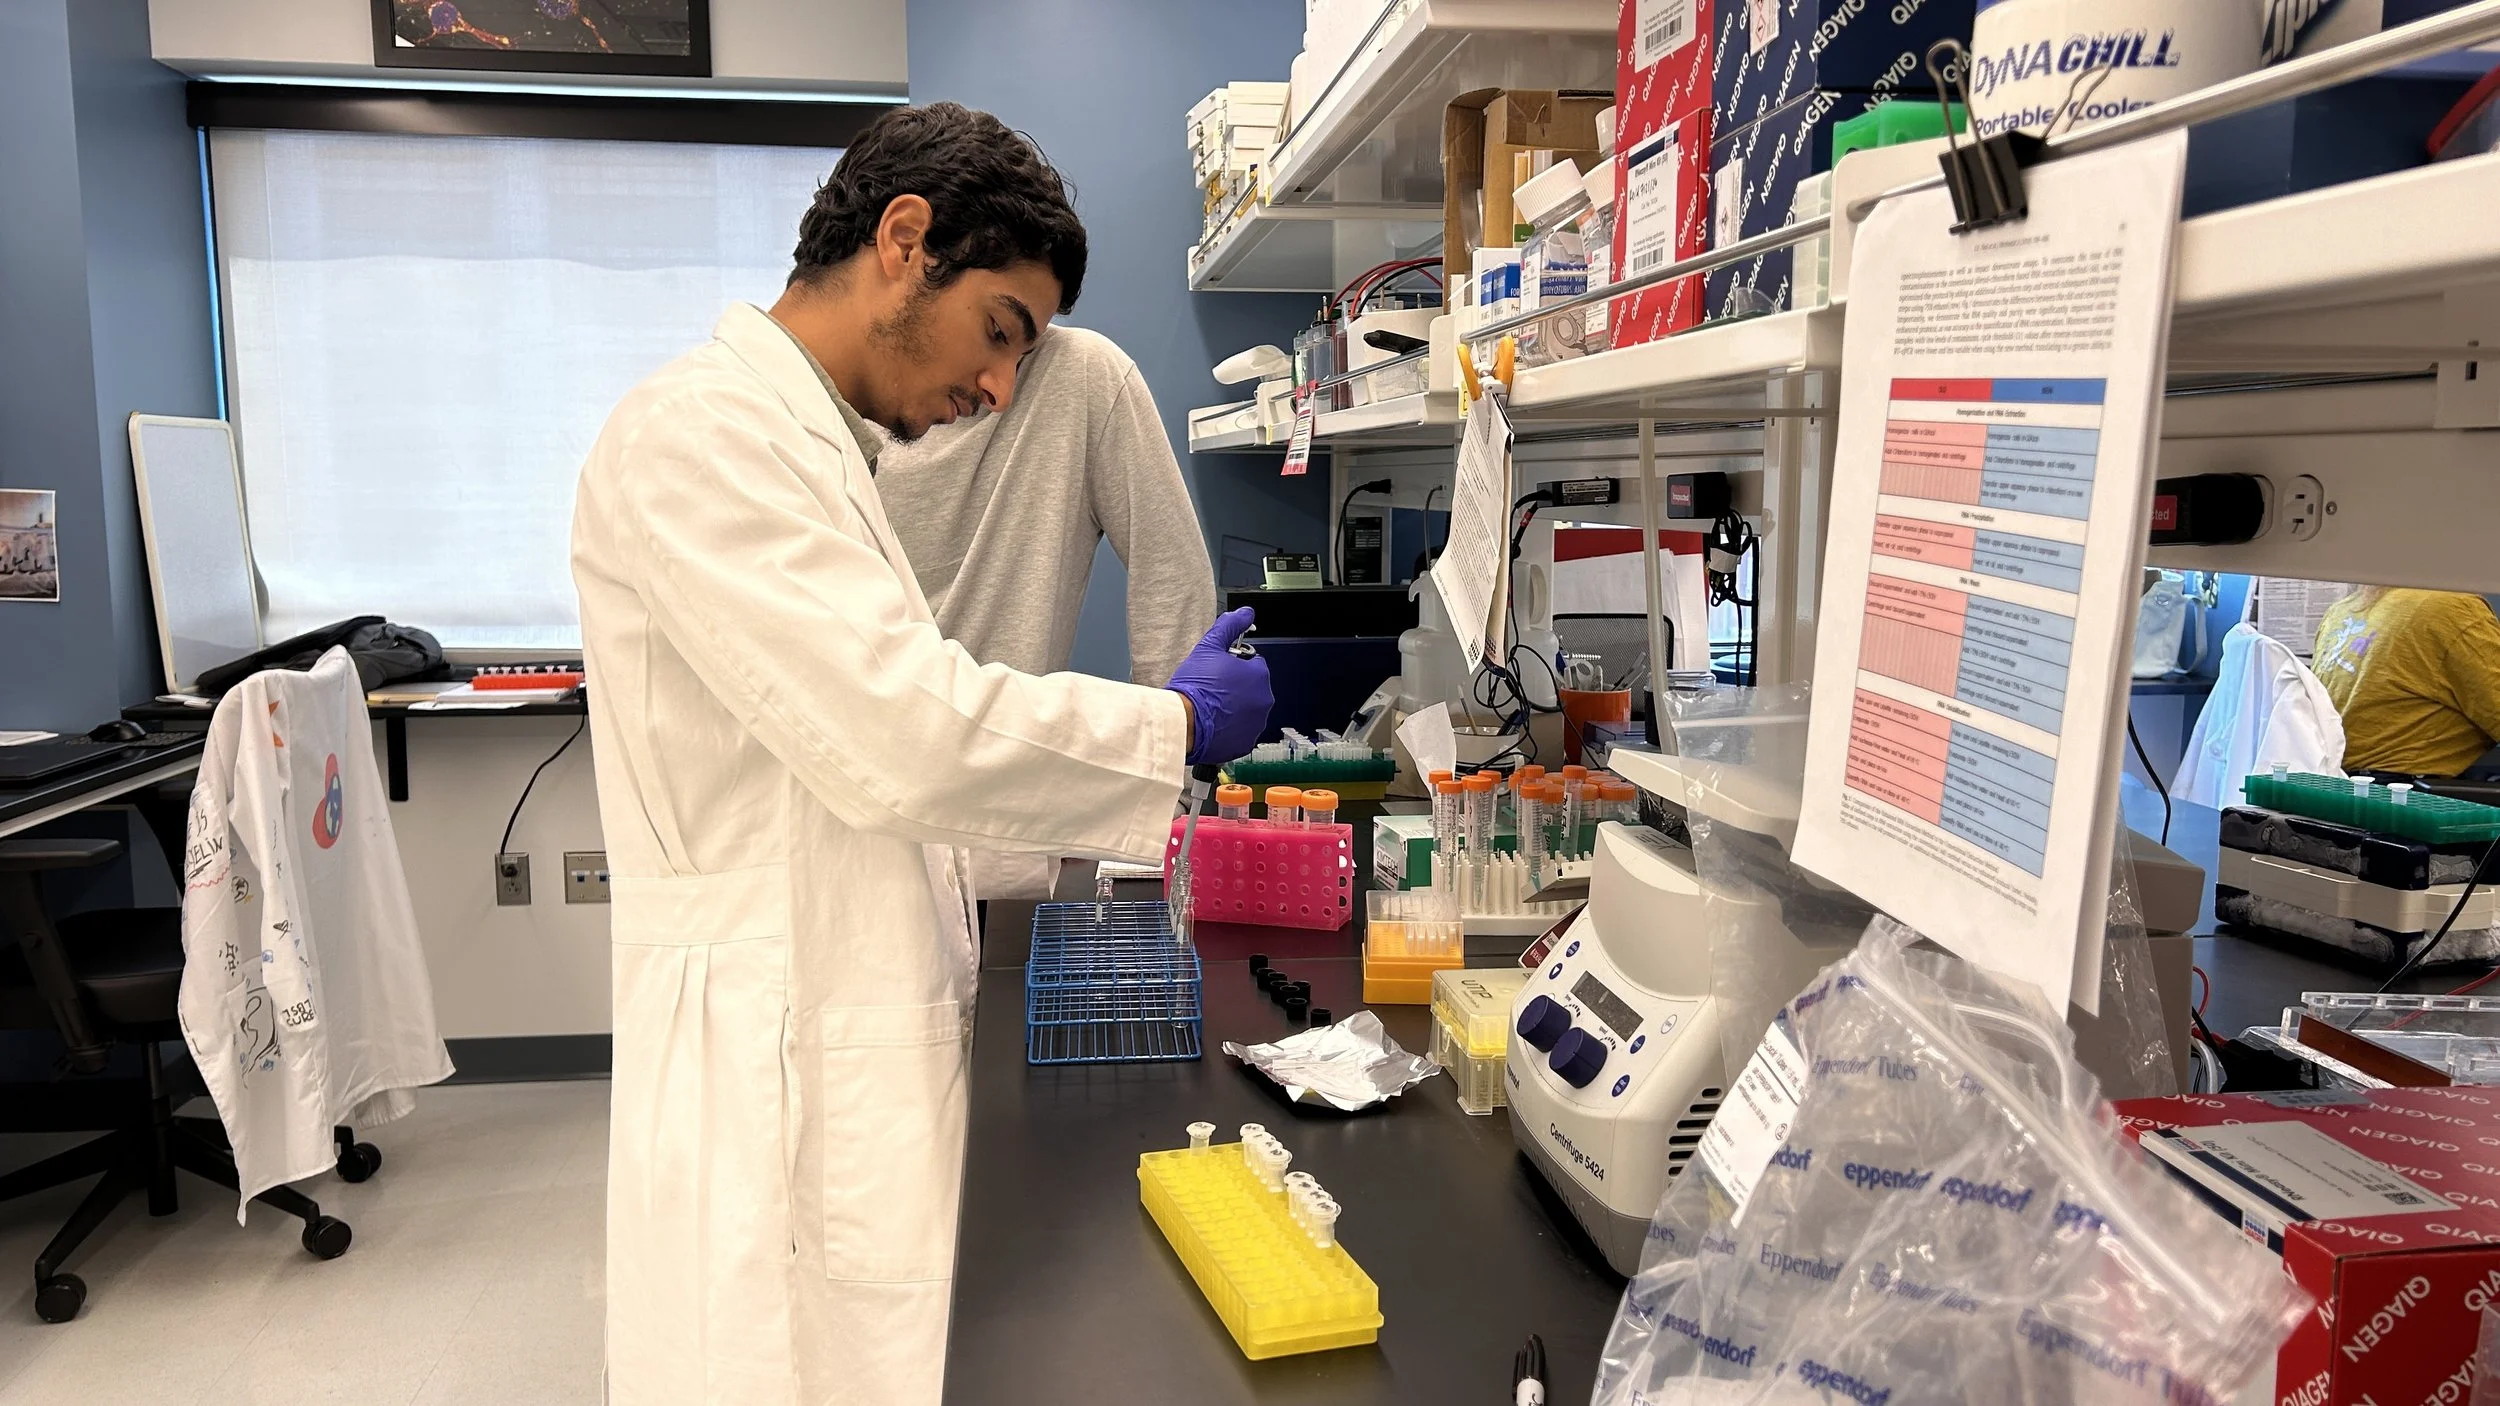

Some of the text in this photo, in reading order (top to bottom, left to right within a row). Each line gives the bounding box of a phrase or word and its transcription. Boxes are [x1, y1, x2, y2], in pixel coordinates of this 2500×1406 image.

[1685, 33, 1708, 98] QIAGEN
[1712, 12, 1733, 81] QIAGEN
[1775, 40, 1802, 108] QIAGEN
[1617, 84, 1637, 142] QIAGEN
[1727, 52, 1750, 122] QIAGEN
[1794, 91, 1842, 156] QIAGEN
[1976, 104, 2055, 135] Portable
[1760, 133, 1786, 205] QIAGEN
[1877, 1056, 1919, 1081] Tubes
[2349, 1126, 2460, 1152] QIAGEN
[2369, 1102, 2476, 1127] QIAGEN
[1550, 1122, 1605, 1182] Centrifuge 5424
[1760, 1243, 1844, 1282] Eppendorf
[2342, 1275, 2431, 1363] QIAGEN
